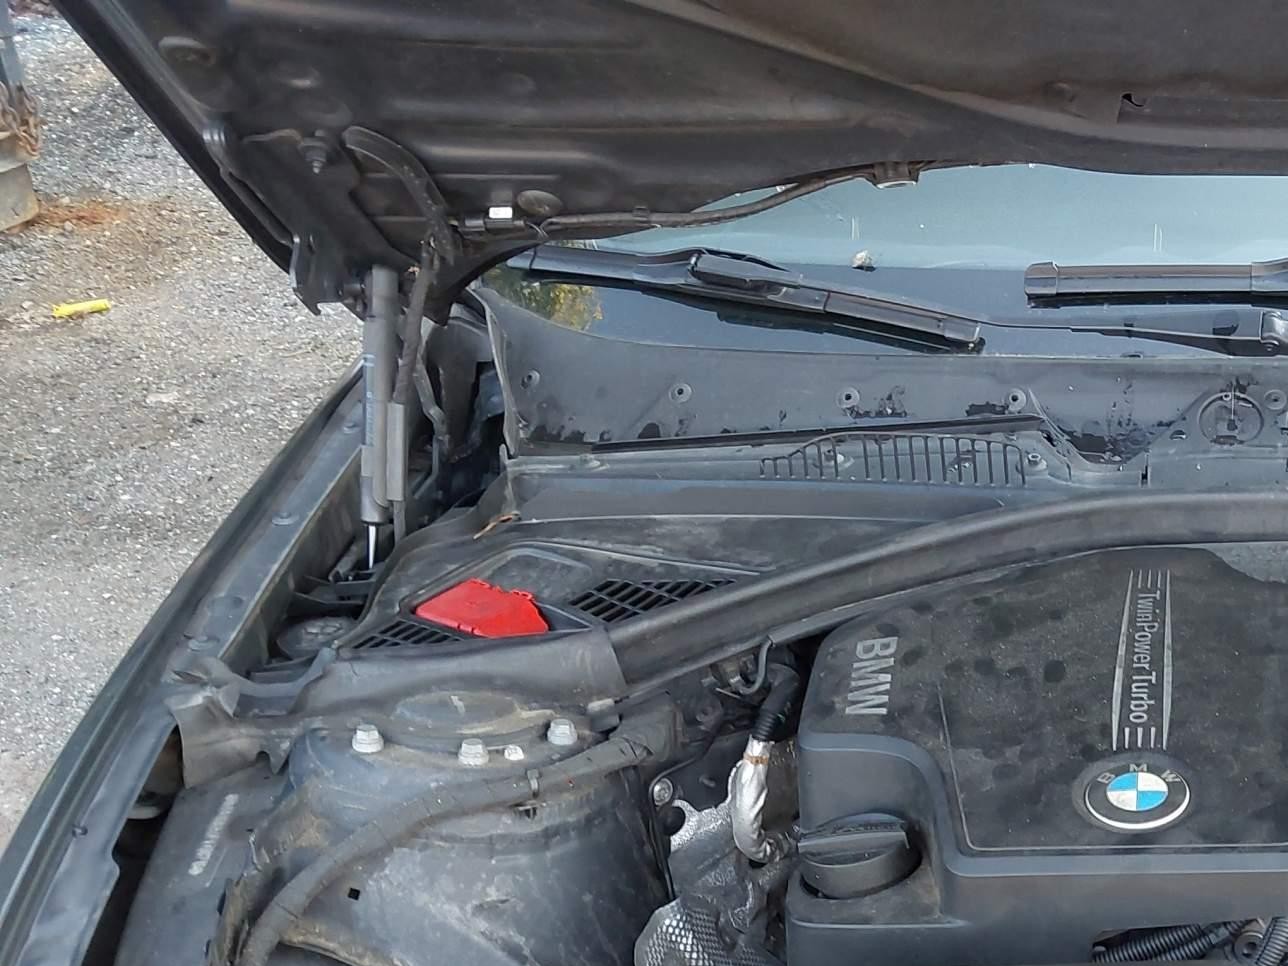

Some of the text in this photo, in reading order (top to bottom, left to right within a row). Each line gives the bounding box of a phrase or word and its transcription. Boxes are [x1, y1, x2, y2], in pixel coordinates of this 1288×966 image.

[845, 636, 899, 715] BMW
[1129, 590, 1161, 724] TwinPower Turbo
[1096, 763, 1181, 784] BMW
